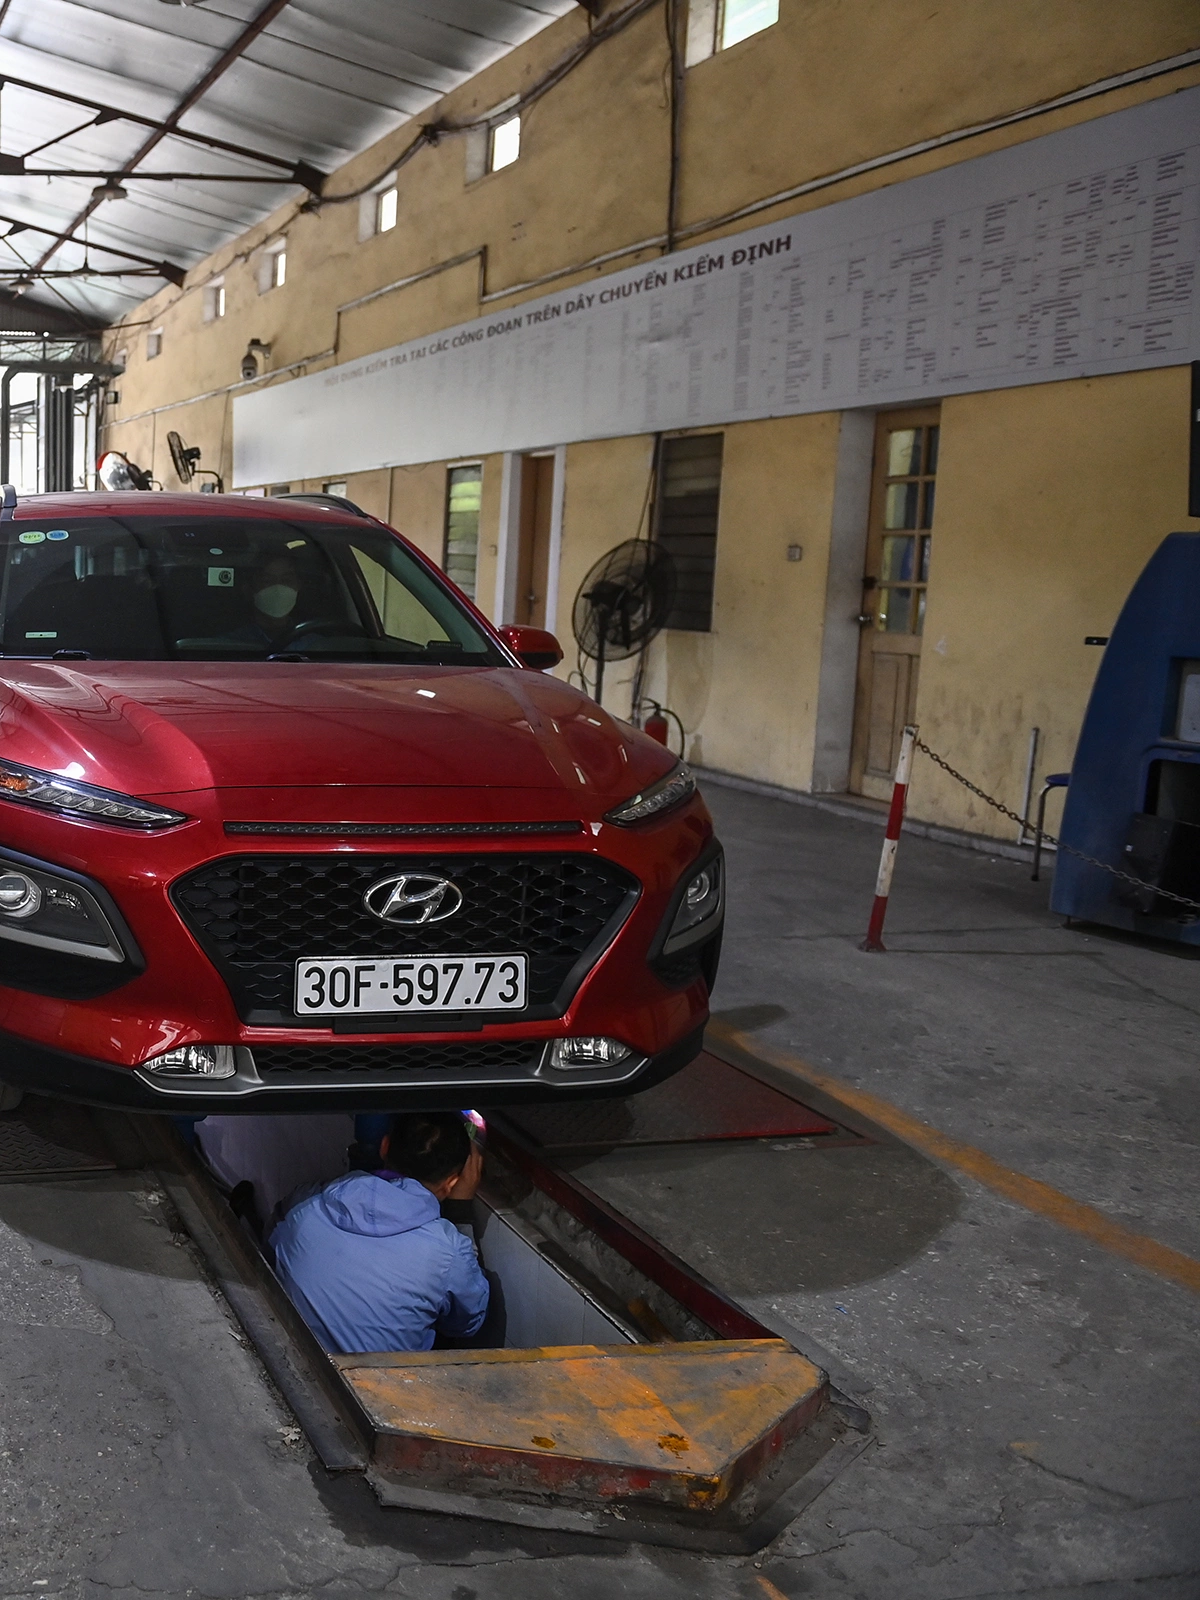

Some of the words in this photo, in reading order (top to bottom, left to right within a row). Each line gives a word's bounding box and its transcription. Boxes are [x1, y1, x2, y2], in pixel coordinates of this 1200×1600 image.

[390, 354, 408, 368] TRA
[428, 338, 450, 355] CÁC
[452, 328, 484, 347] CÔNG
[487, 317, 522, 338] ĐOẠN
[526, 304, 562, 326] TRÊN
[565, 293, 596, 315] DÂY
[673, 253, 726, 284] KIỂM
[731, 234, 793, 266] ĐỊNH
[302, 961, 520, 1009] 30F-597.73
